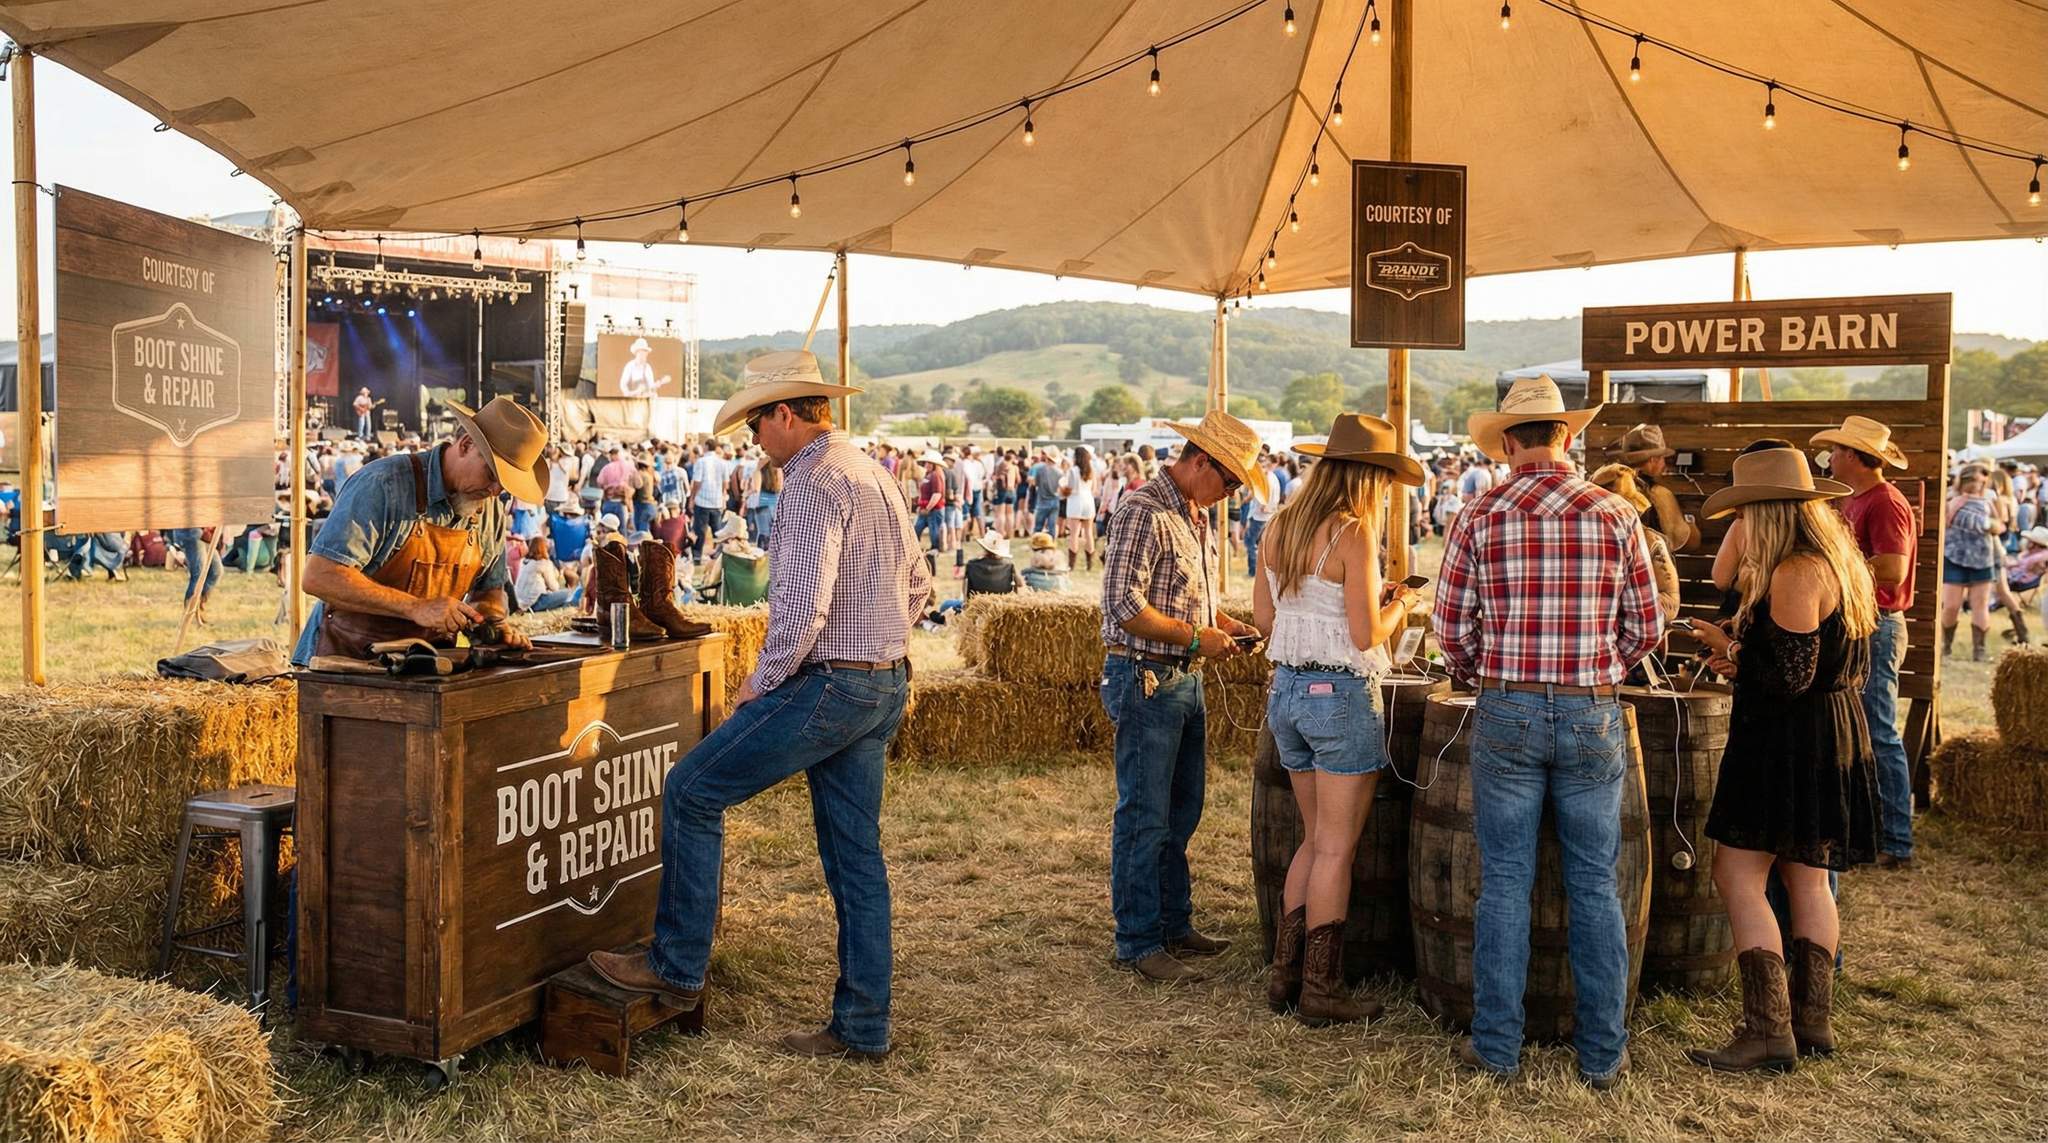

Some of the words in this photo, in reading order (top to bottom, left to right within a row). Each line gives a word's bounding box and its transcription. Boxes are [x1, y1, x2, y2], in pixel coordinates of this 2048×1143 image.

[1366, 204, 1432, 224] COURTESY
[1436, 207, 1453, 225] OF
[142, 256, 199, 289] COURTESY
[202, 271, 215, 294] OF
[1625, 316, 1766, 355] POWER
[1780, 312, 1898, 352] BARN
[134, 335, 176, 371] BOOT
[180, 342, 224, 376] SHINE
[143, 372, 156, 405] &
[162, 375, 215, 409] REPAIR
[496, 766, 583, 846] BOOT
[593, 741, 679, 815] SHINE
[526, 840, 548, 895] &
[559, 806, 656, 885] REPAIR
